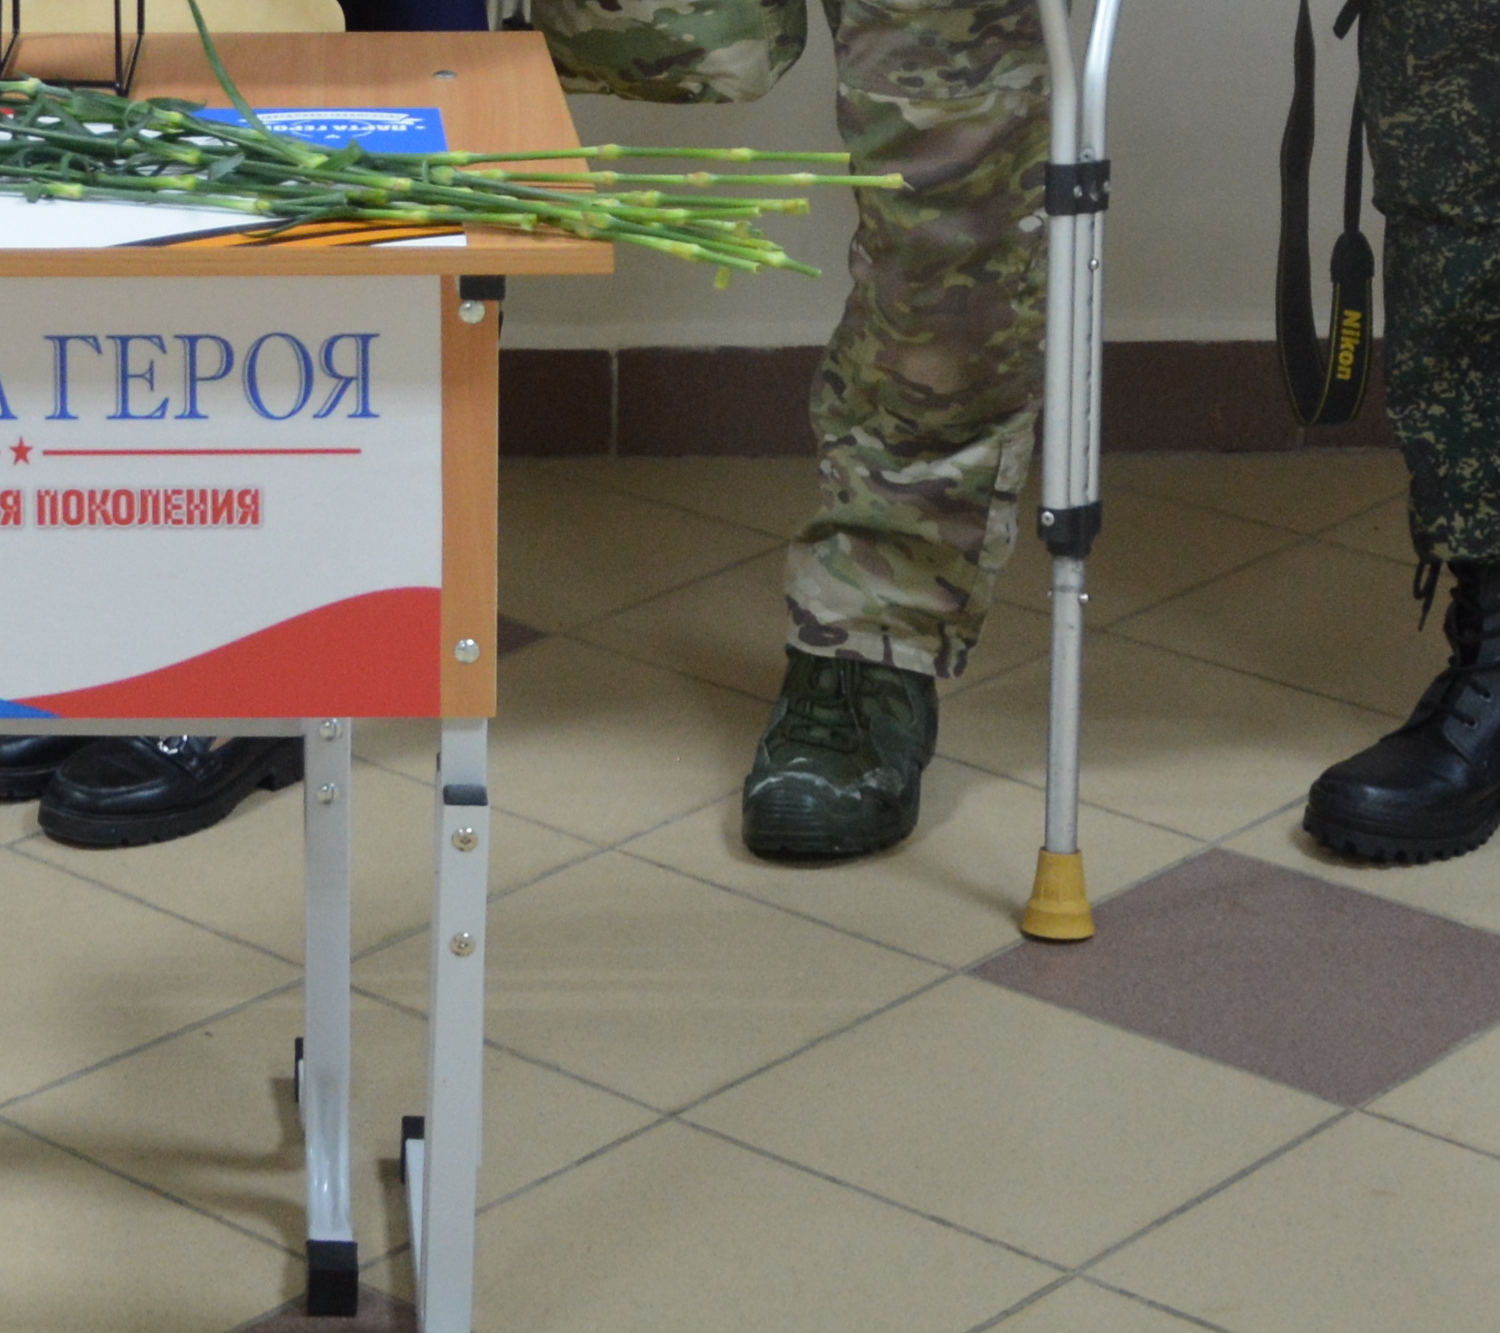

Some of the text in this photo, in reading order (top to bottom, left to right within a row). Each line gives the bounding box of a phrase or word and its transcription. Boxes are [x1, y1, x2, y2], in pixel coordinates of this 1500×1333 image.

[42, 332, 383, 424] ГЕРОЯ
[1338, 309, 1362, 380] Nikon
[35, 483, 264, 532] ПОКОЛЕНИЯ
